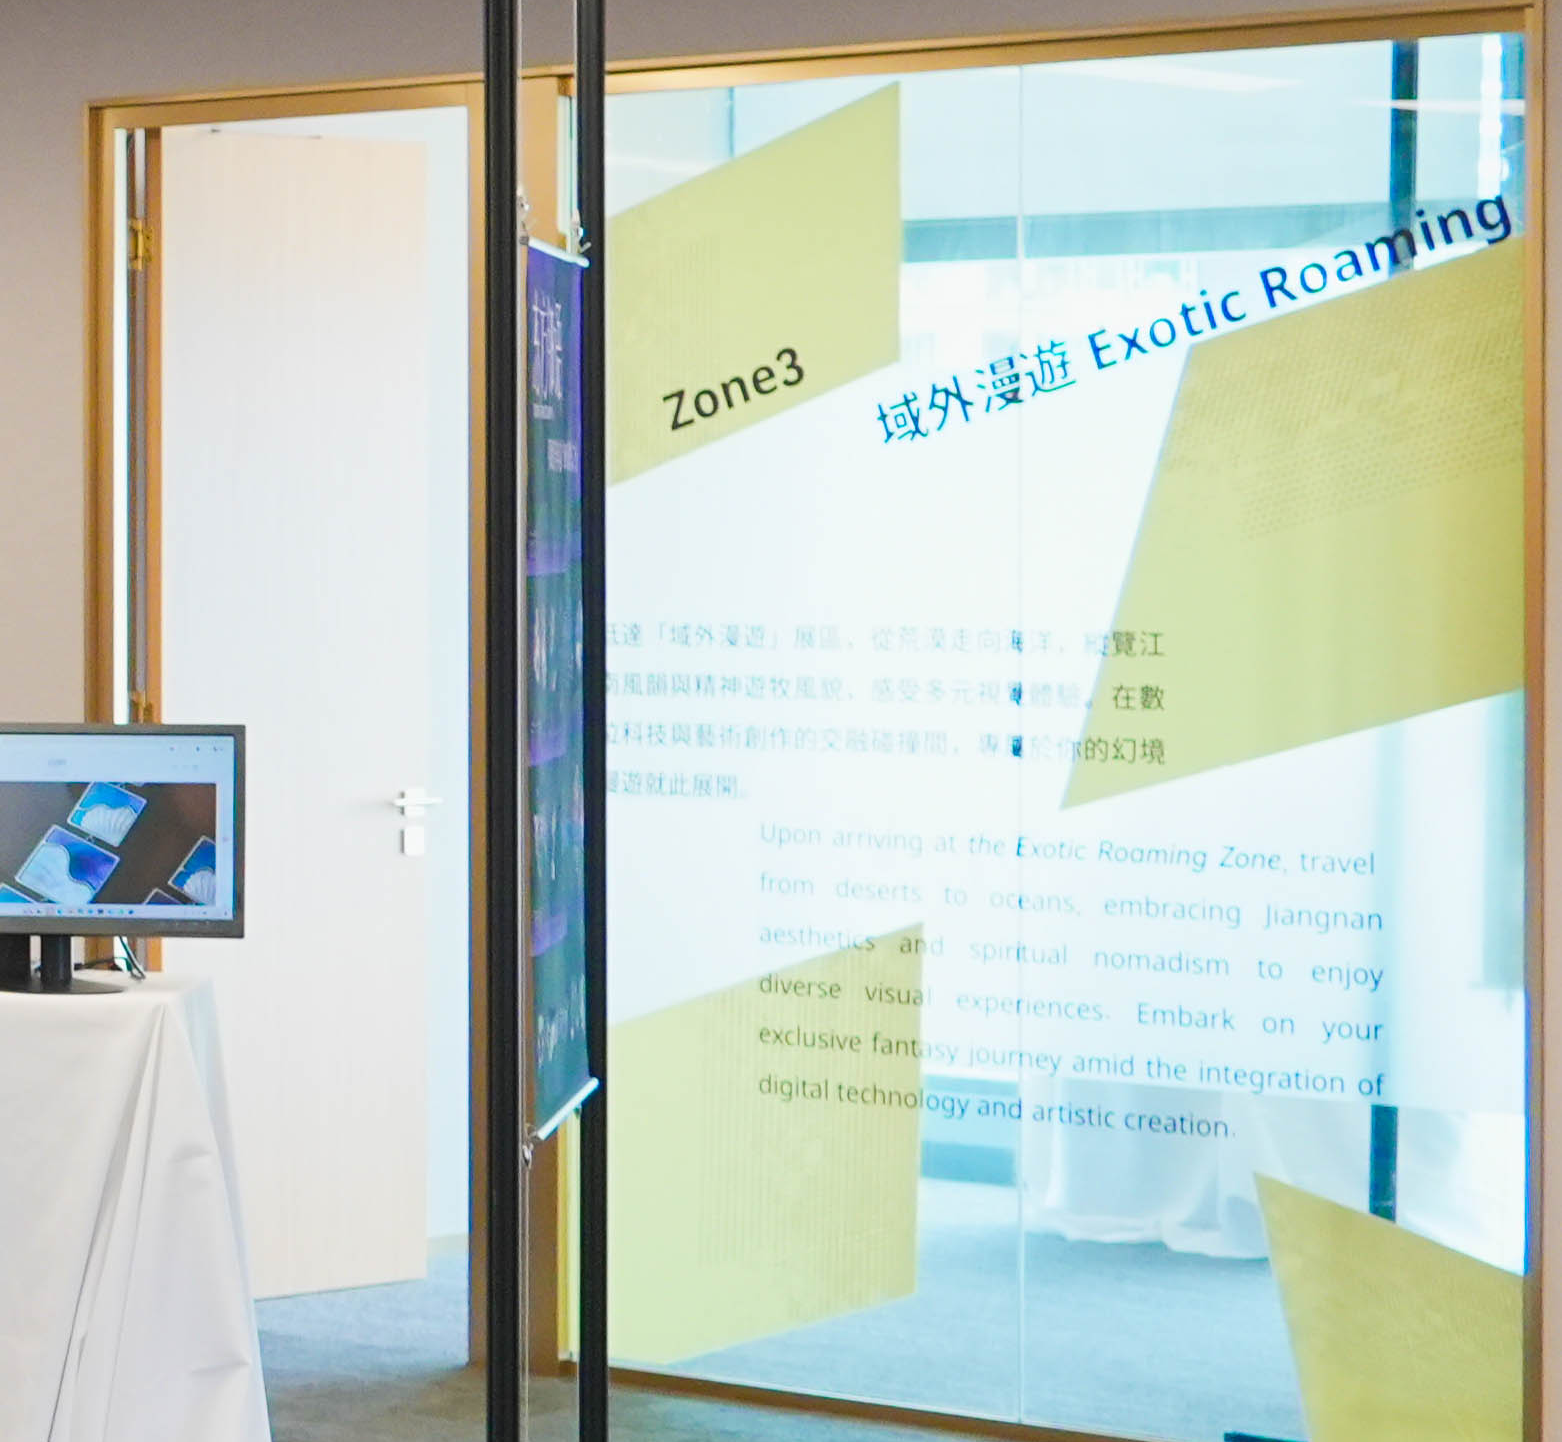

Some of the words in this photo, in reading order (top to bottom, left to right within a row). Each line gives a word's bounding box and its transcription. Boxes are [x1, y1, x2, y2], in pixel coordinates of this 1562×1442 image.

[877, 340, 1075, 444] 域外漫遊
[1090, 285, 1246, 371] Exotic
[1261, 193, 1514, 308] Roaming
[662, 347, 807, 433] Zone3
[760, 822, 822, 848] Upon
[832, 829, 923, 857] arriving
[935, 834, 956, 853] at
[969, 836, 1006, 857] the
[1016, 836, 1087, 861] Exotic
[1098, 840, 1207, 872] Roaming
[1219, 845, 1287, 875] Zone,
[1300, 852, 1375, 875] travel
[760, 871, 814, 895] from
[836, 878, 922, 902] deserts
[944, 886, 967, 907] to
[1104, 896, 1241, 929] embracing
[1263, 904, 1383, 934] Jiangnan
[760, 925, 875, 952] aesthetics
[900, 936, 944, 956] and
[969, 940, 1067, 966] spiritual
[1094, 950, 1230, 976] nomadism
[1258, 959, 1283, 980] to
[1312, 965, 1384, 991] enjoy
[759, 974, 841, 999] diverse
[865, 982, 933, 1005] visual
[956, 992, 1111, 1022] experiences.
[1137, 1002, 1236, 1030] Embark
[1262, 1015, 1295, 1035] on
[1322, 1020, 1384, 1045] your
[759, 1025, 862, 1052] exclusive
[872, 1031, 959, 1065] fantasy
[968, 1043, 1062, 1076] journey
[1072, 1055, 1135, 1077] amid
[1147, 1057, 1188, 1080] the
[1200, 1061, 1345, 1094] integration
[1358, 1073, 1385, 1097] of
[759, 1074, 829, 1103] digital
[838, 1083, 970, 1120] technology
[978, 1099, 1023, 1120] and
[1032, 1101, 1115, 1129] artistic
[1124, 1110, 1236, 1139] creation.
